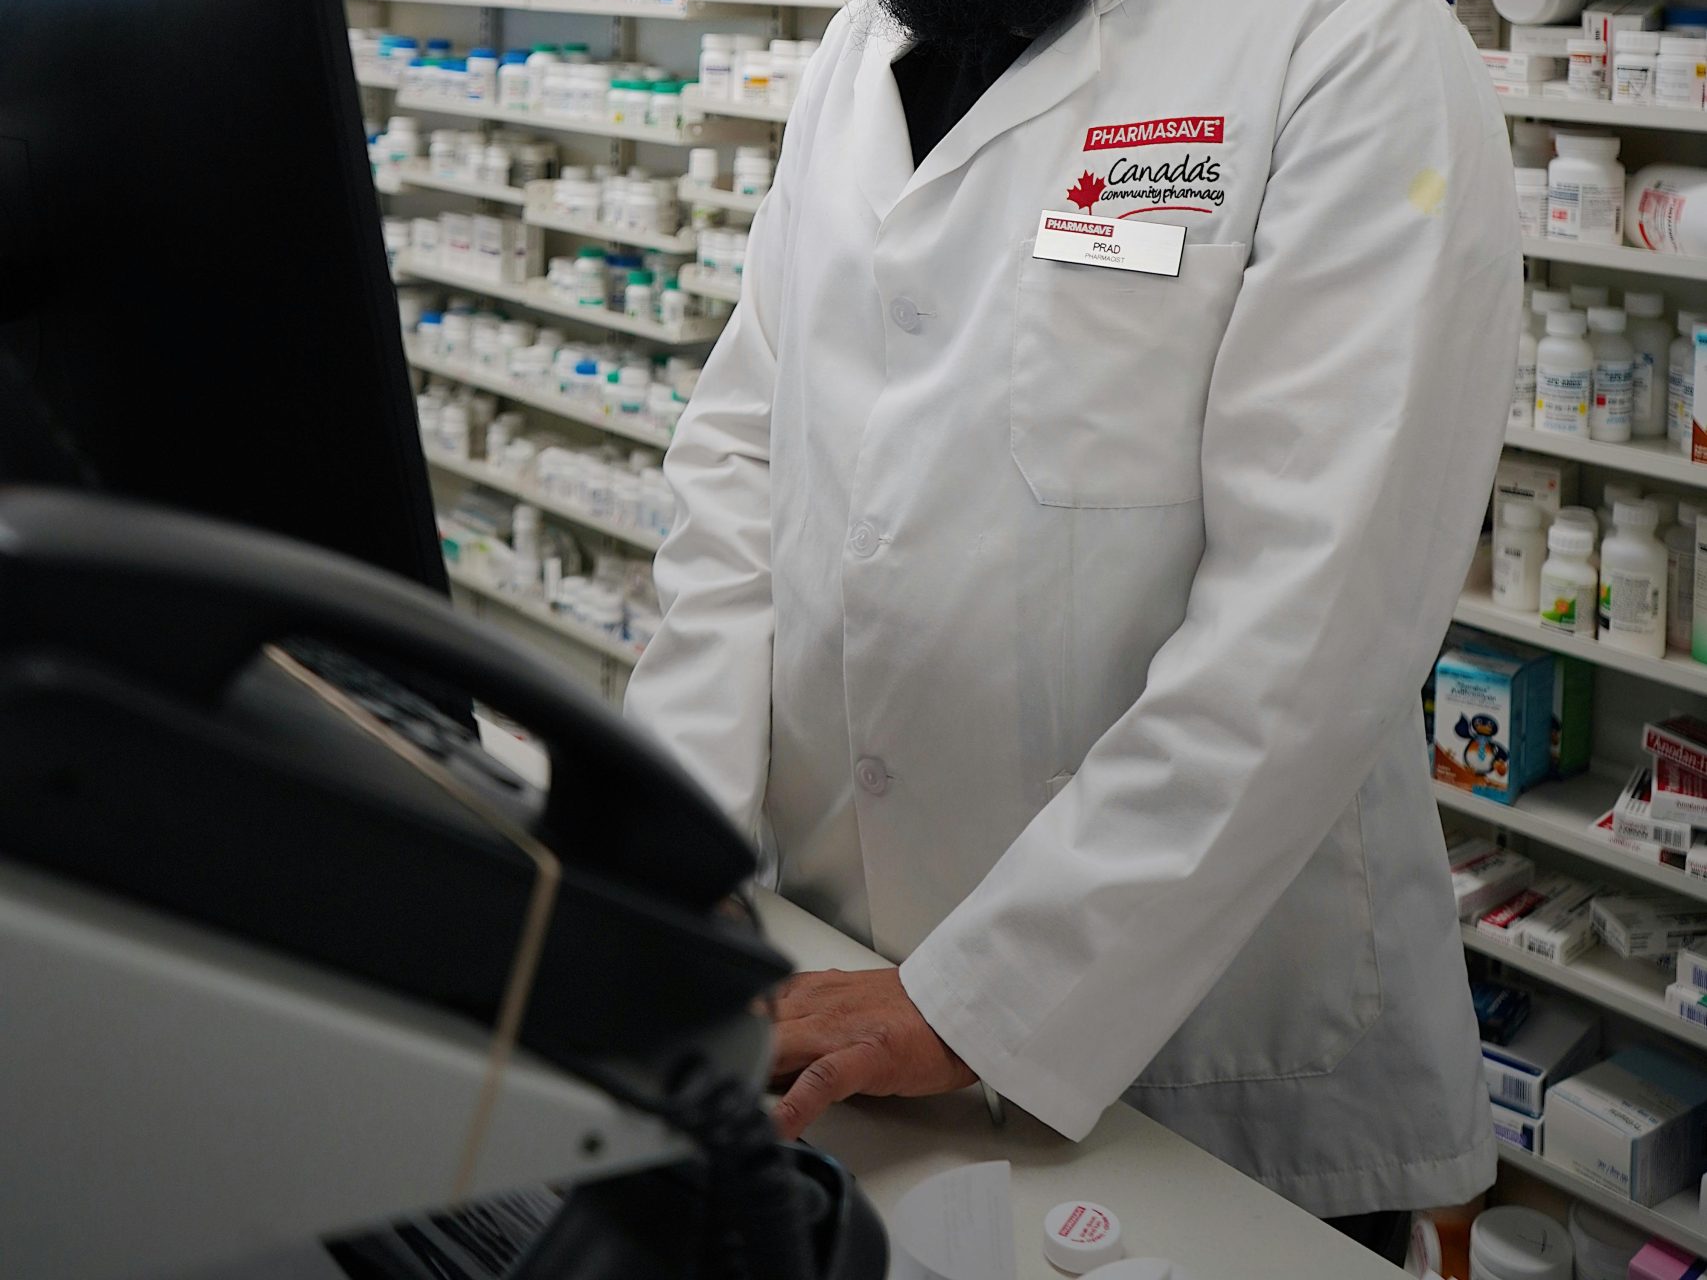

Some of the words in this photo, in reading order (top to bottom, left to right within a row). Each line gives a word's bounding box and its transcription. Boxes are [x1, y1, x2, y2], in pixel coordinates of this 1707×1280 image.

[1090, 120, 1217, 146] PHARMASAVE
[1108, 153, 1221, 185] Canada's
[1046, 219, 1113, 236] PHARMASAVE
[1092, 242, 1121, 254] PRAD
